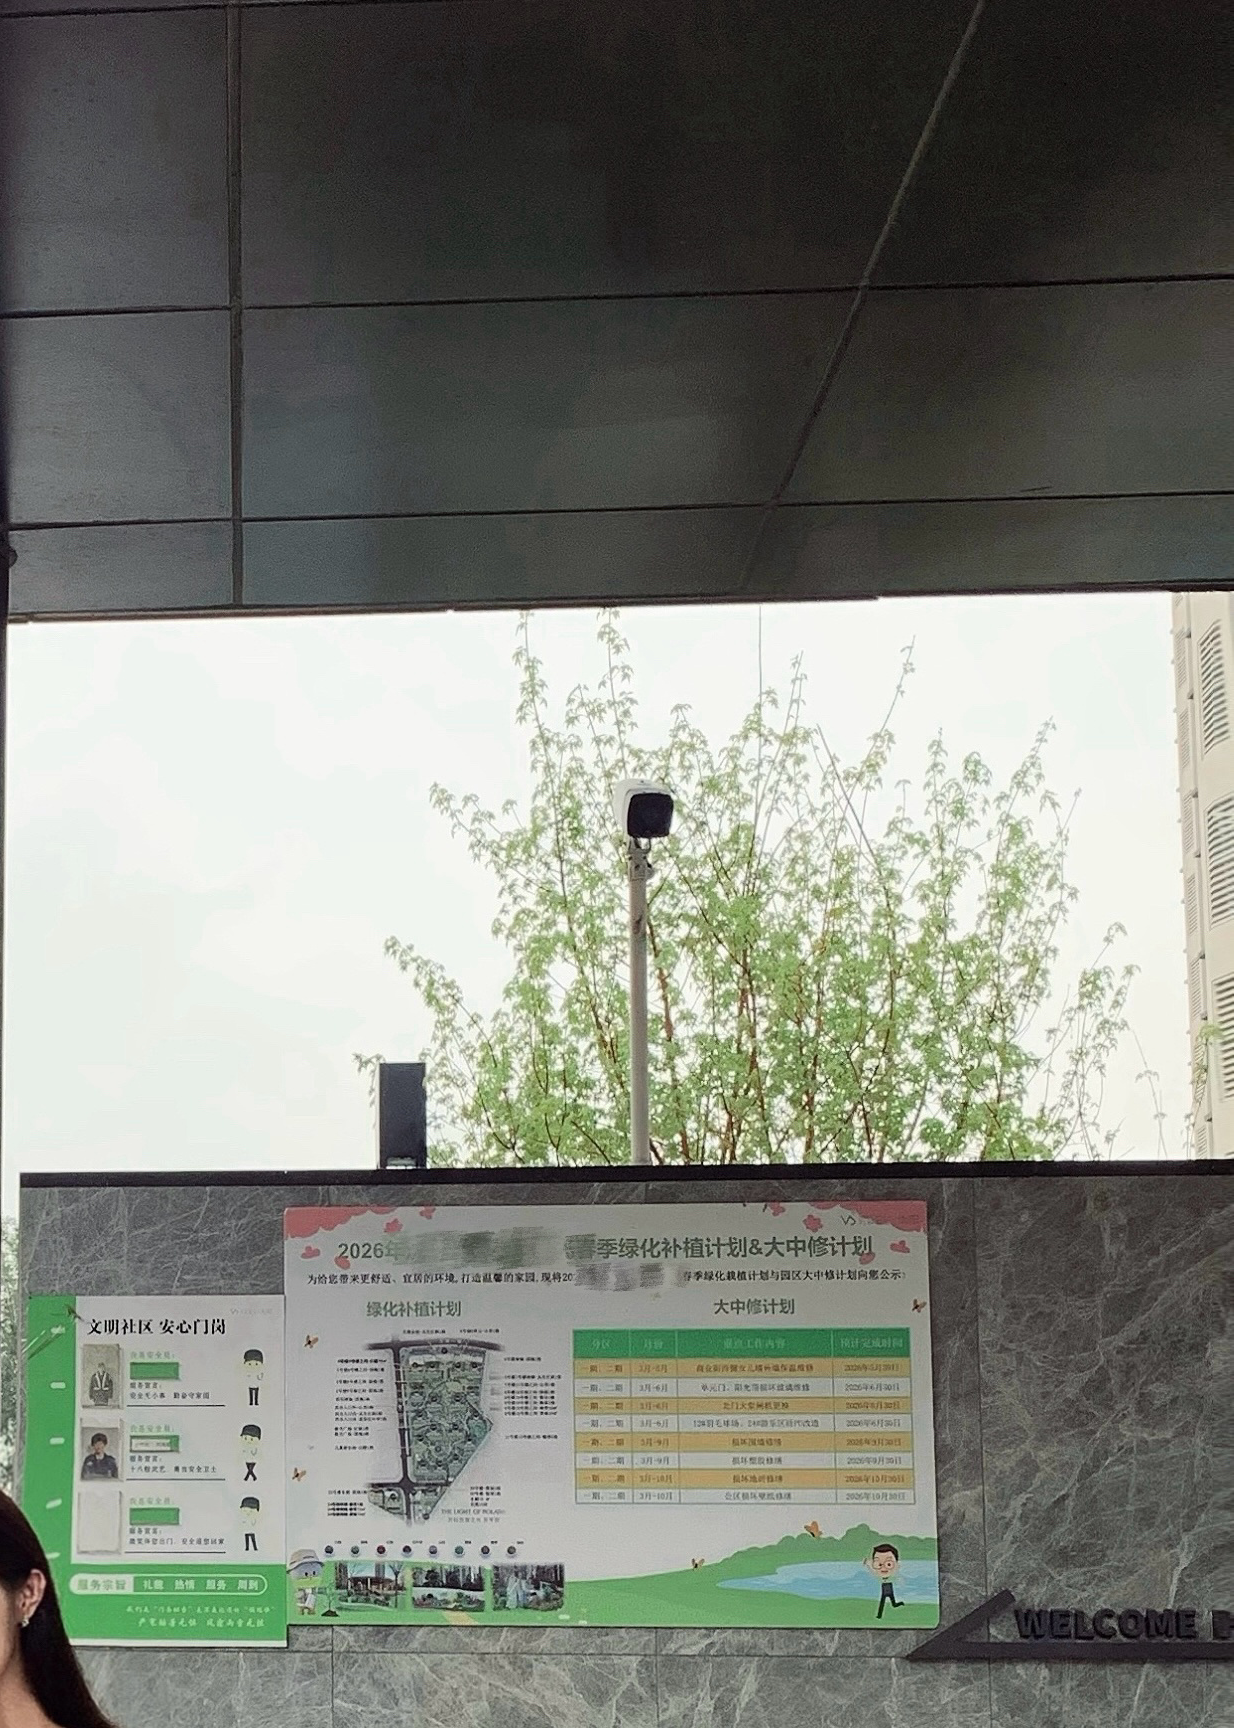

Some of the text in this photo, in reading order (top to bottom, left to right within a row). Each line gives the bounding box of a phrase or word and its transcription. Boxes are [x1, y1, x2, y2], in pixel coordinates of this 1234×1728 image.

[366, 1301, 462, 1317] 绿化补植计划
[714, 1299, 795, 1315] 大中修计划
[87, 1318, 226, 1335] 文明社区 安心门岗
[1015, 1608, 1198, 1641] WELCOME
